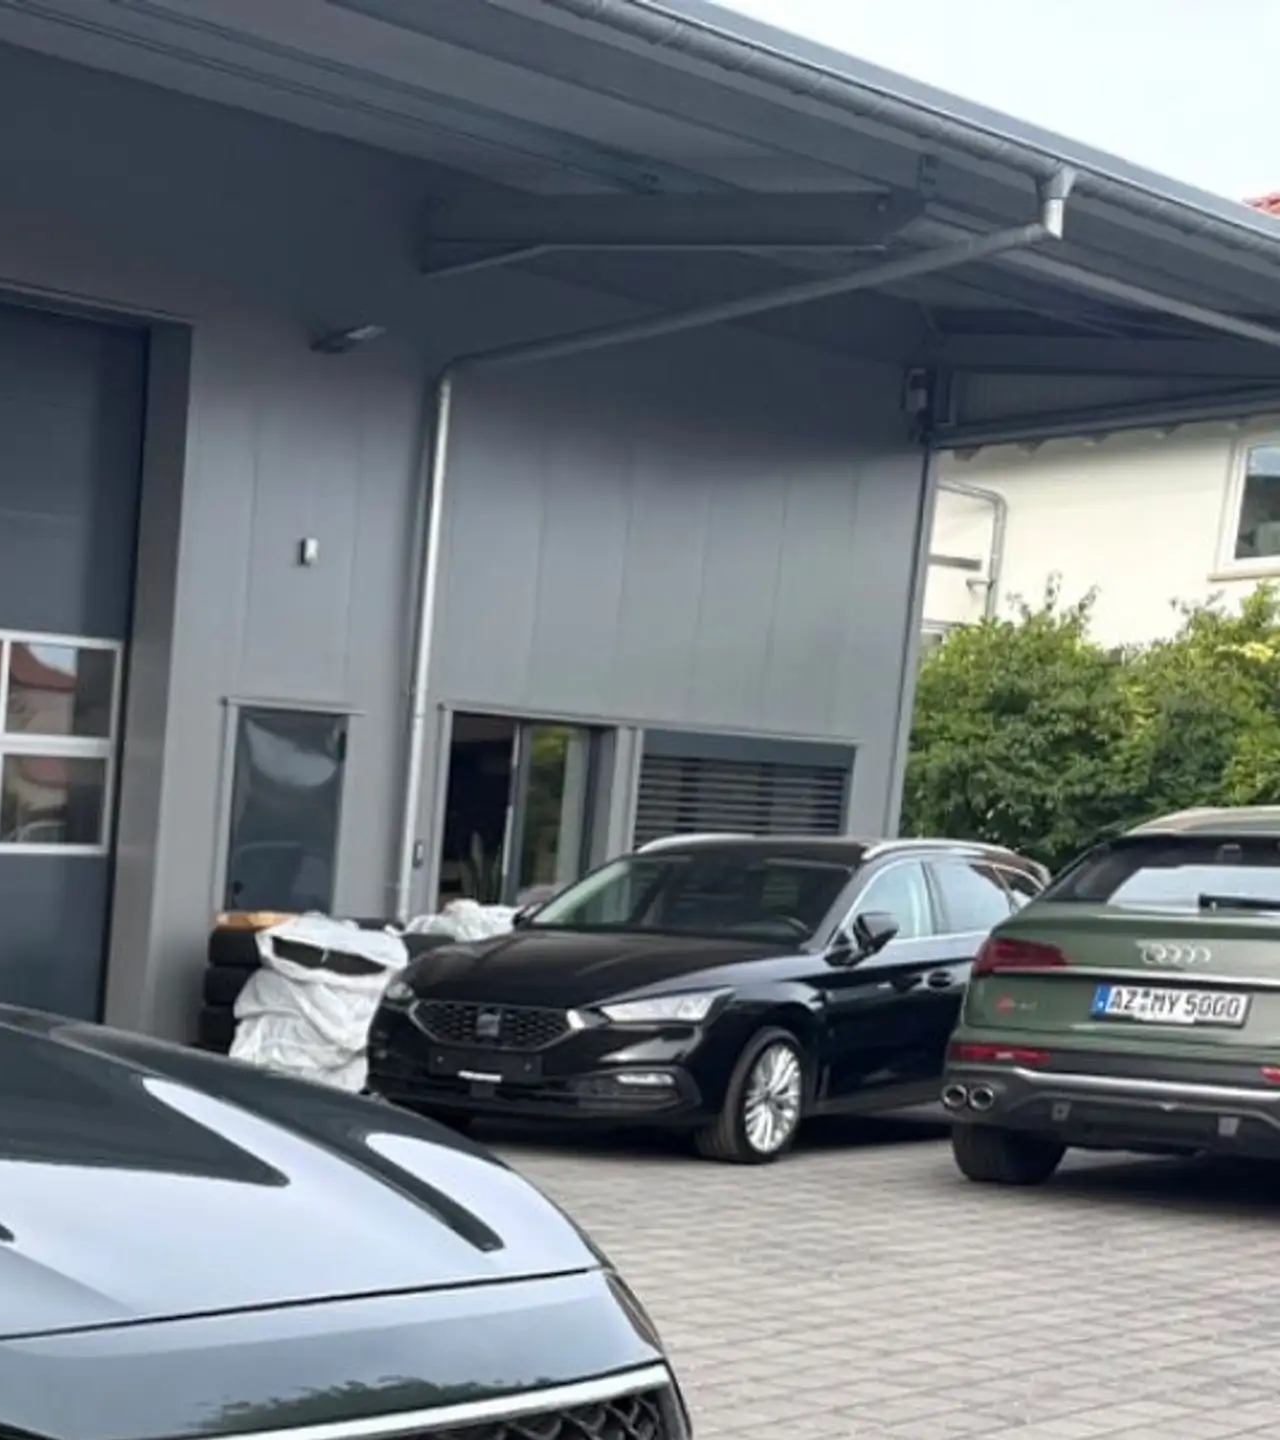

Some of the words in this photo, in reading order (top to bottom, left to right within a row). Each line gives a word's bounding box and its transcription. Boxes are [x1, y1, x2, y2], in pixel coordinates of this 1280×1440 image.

[1109, 988, 1138, 1011] AZ
[1149, 991, 1181, 1014] MY
[1183, 993, 1241, 1018] 5000
